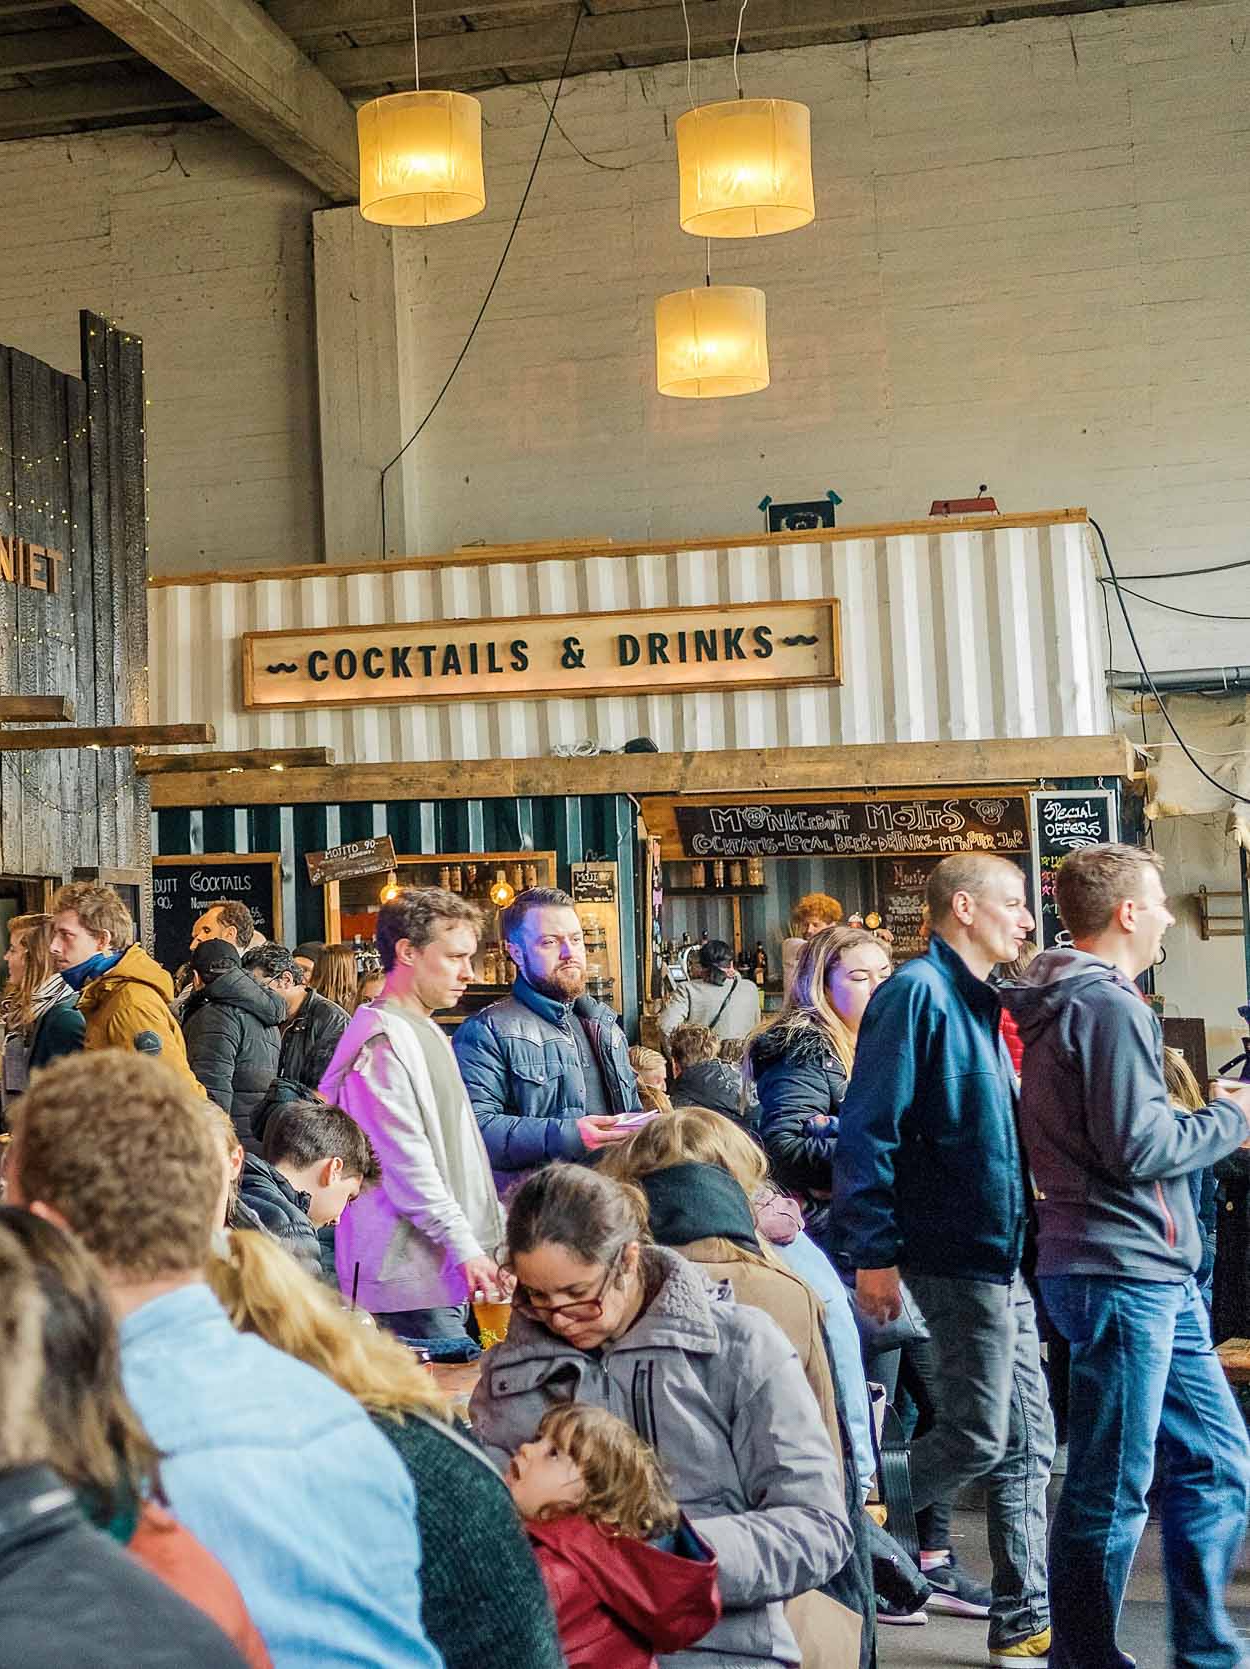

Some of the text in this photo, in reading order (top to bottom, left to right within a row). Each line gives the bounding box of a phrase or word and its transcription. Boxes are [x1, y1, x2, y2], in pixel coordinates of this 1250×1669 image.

[307, 625, 774, 681] COCKTAILS & DRINKS
[1044, 820, 1102, 837] OFFERS
[324, 843, 359, 860] MOJITO
[190, 871, 252, 892] COCKTAILS
